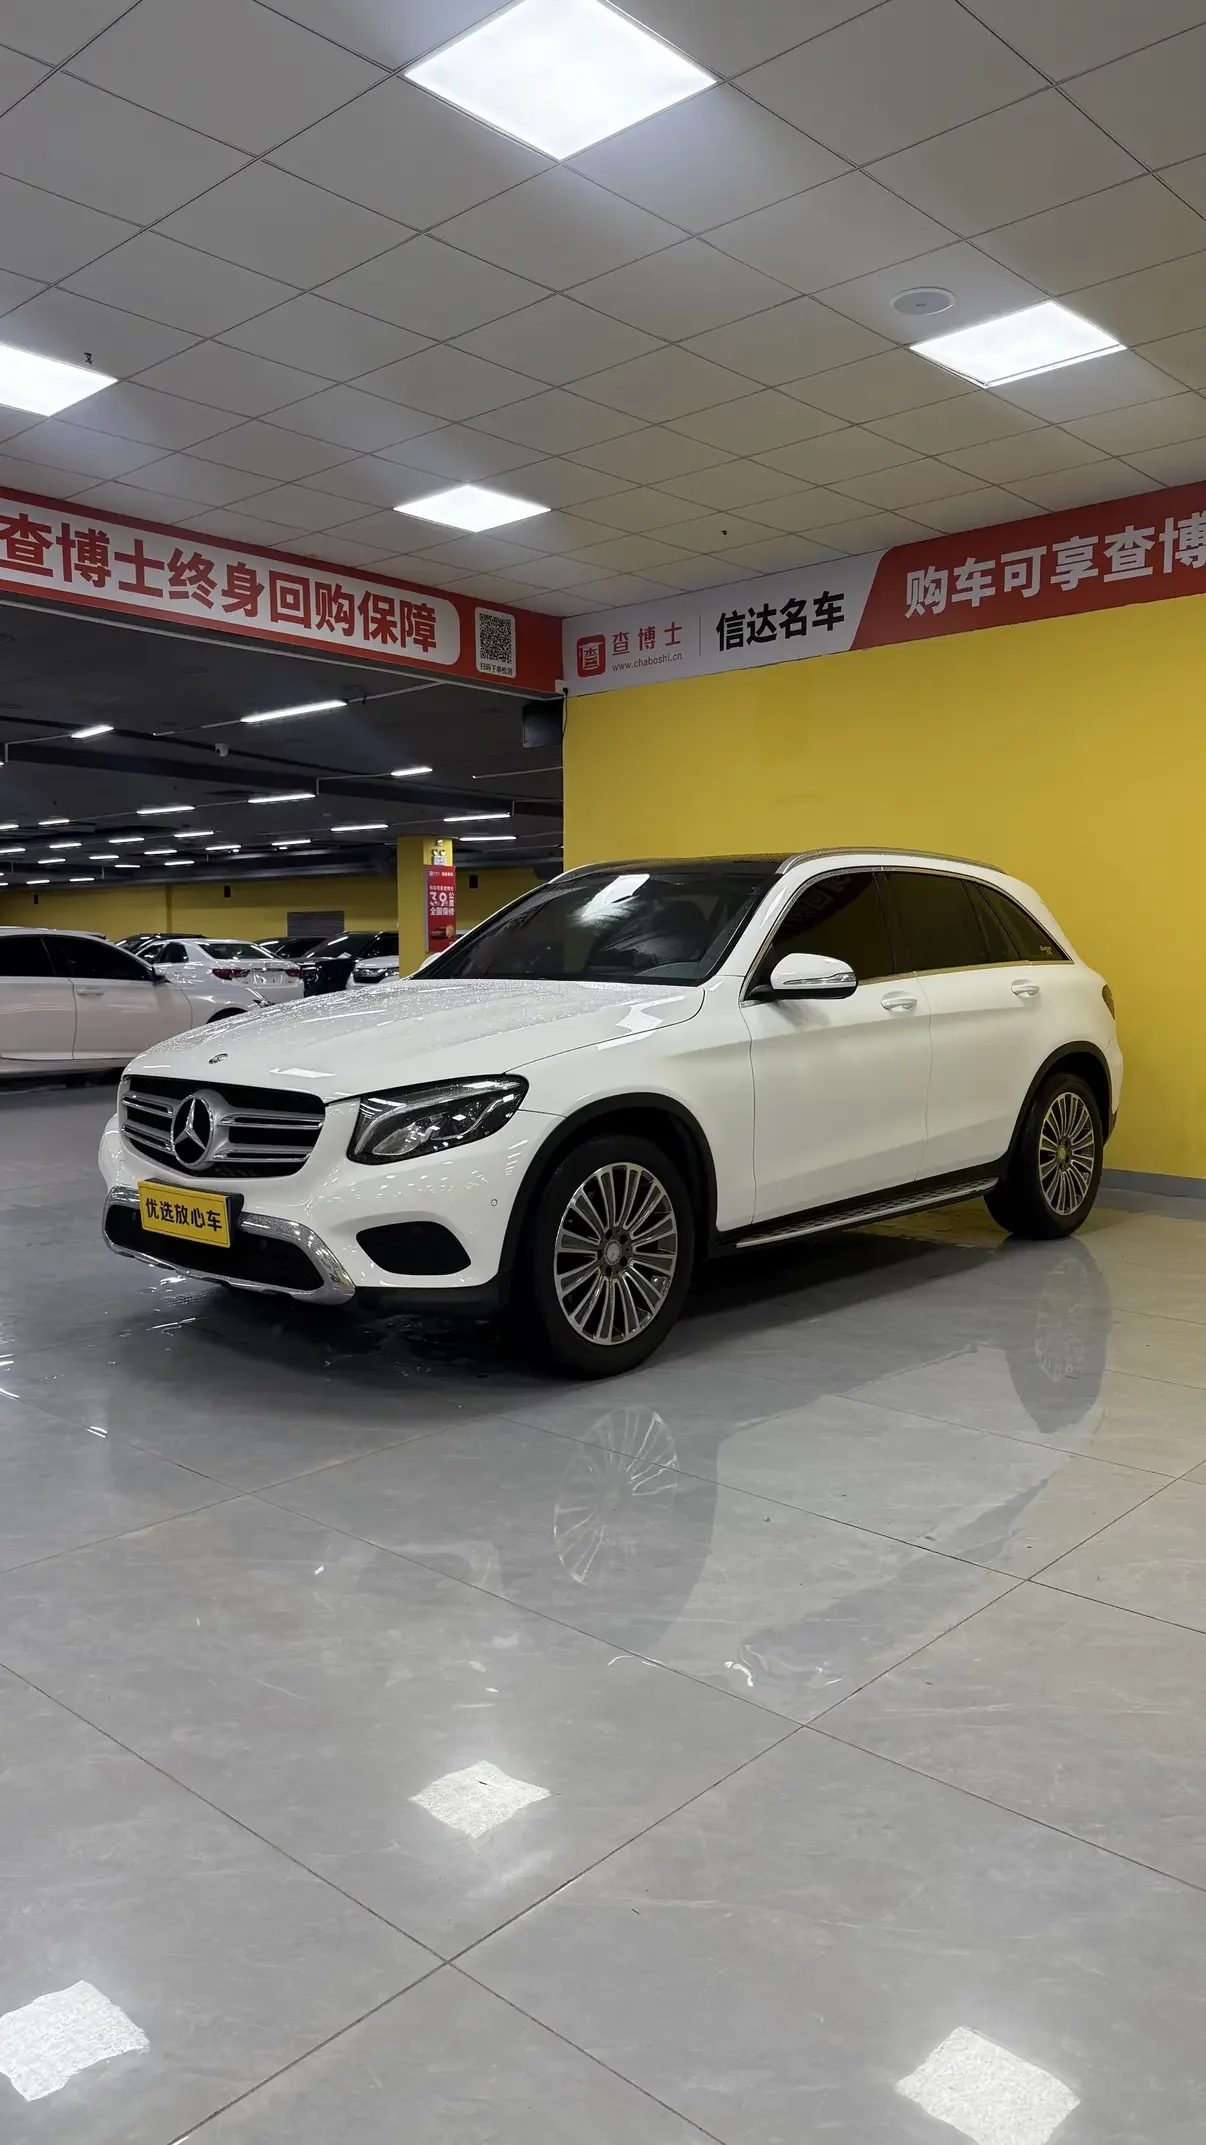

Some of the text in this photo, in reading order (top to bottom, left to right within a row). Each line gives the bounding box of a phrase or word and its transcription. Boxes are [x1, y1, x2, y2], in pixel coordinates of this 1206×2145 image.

[0, 513, 436, 653] 查博士终身回购保障
[716, 590, 845, 651] 信达名车
[612, 622, 683, 656] 查博士
[612, 652, 683, 672] www.chaboshi.cn
[145, 1197, 222, 1232] 优选放心车
